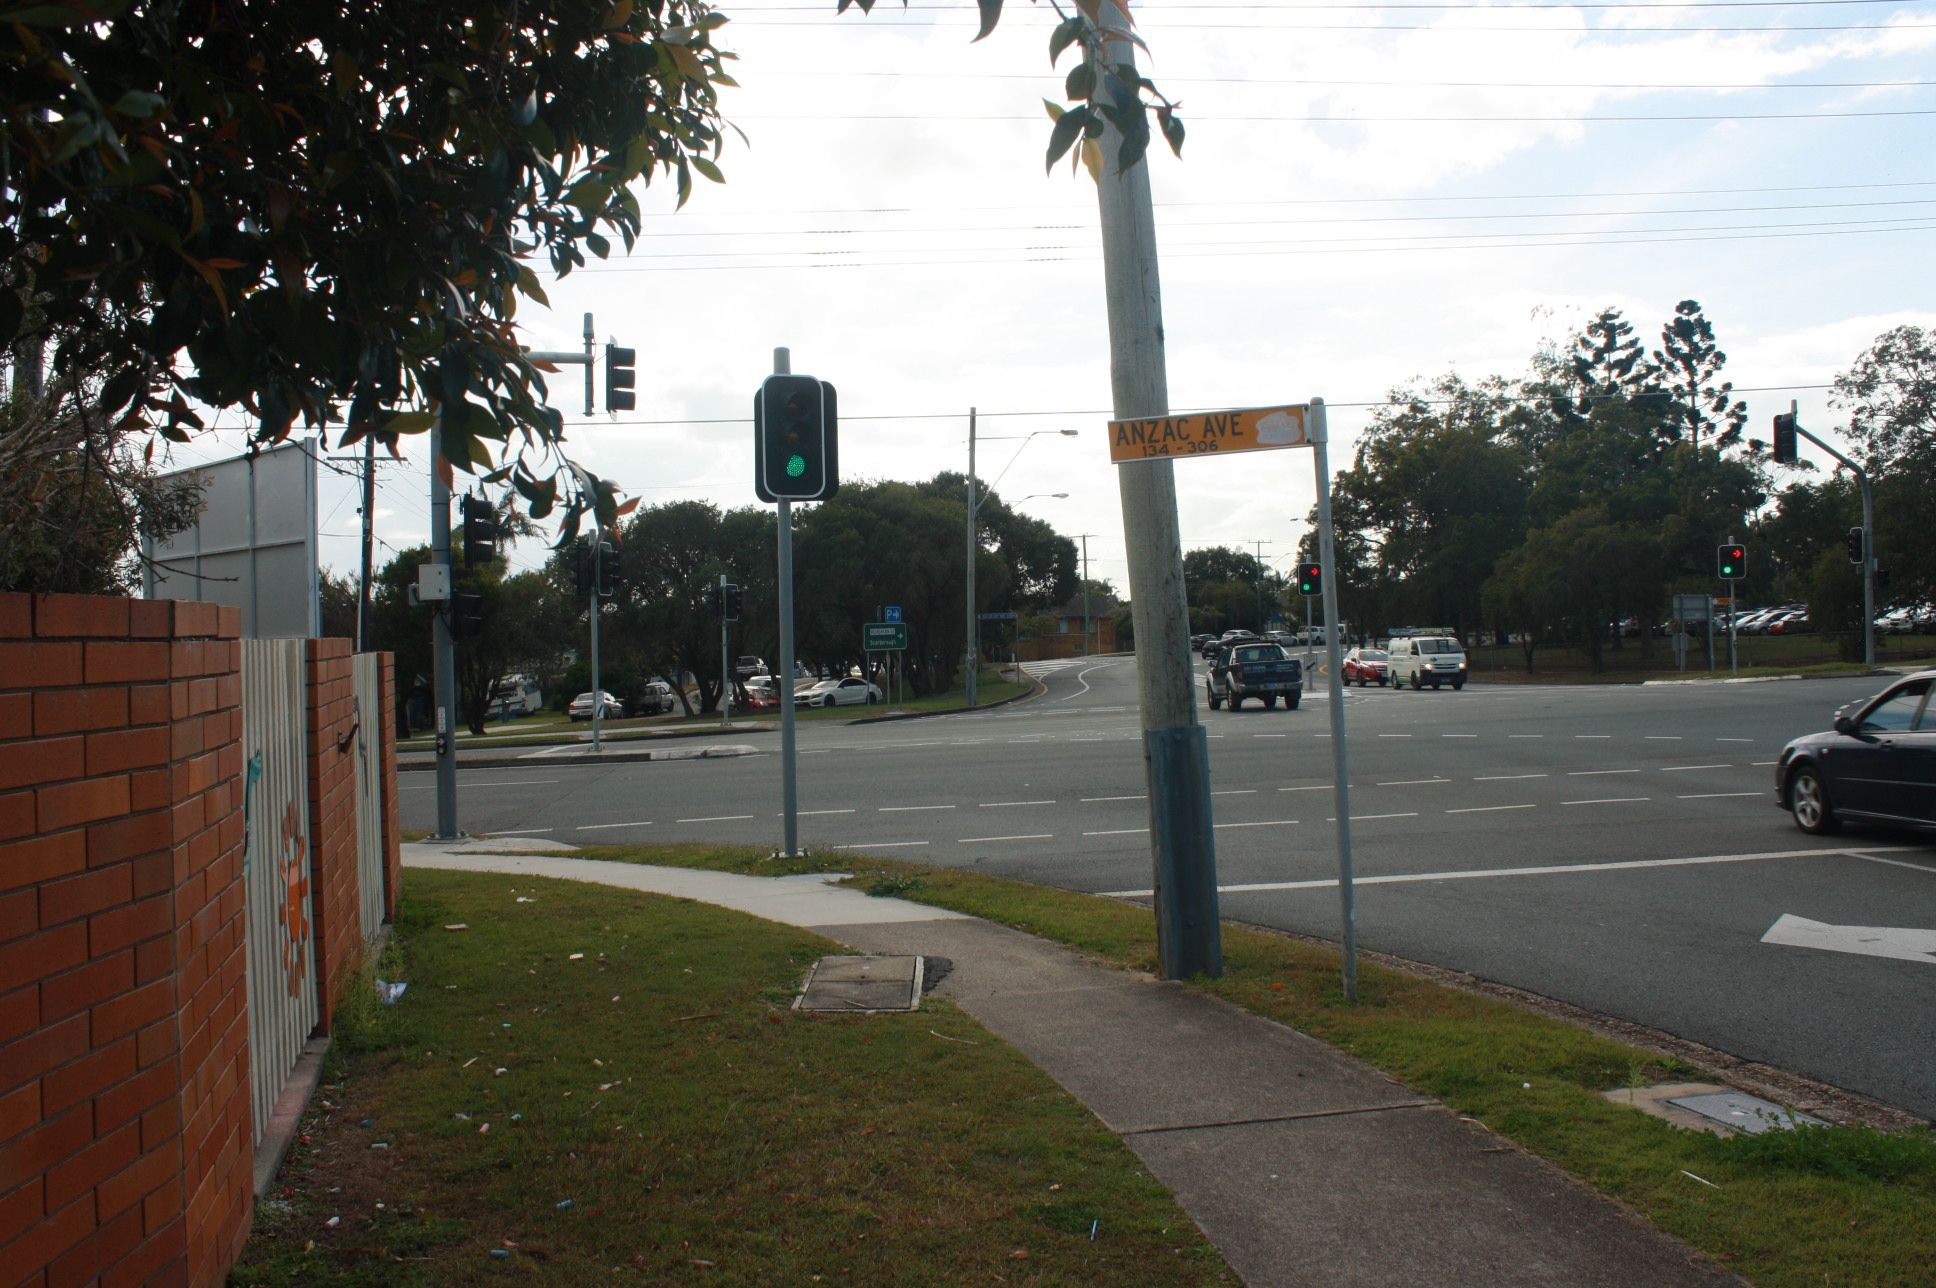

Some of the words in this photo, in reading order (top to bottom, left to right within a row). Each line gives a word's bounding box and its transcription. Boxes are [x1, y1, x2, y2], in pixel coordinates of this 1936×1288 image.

[1116, 418, 1190, 446] ANZAC
[1203, 413, 1243, 438] AVE
[886, 609, 893, 620] P
